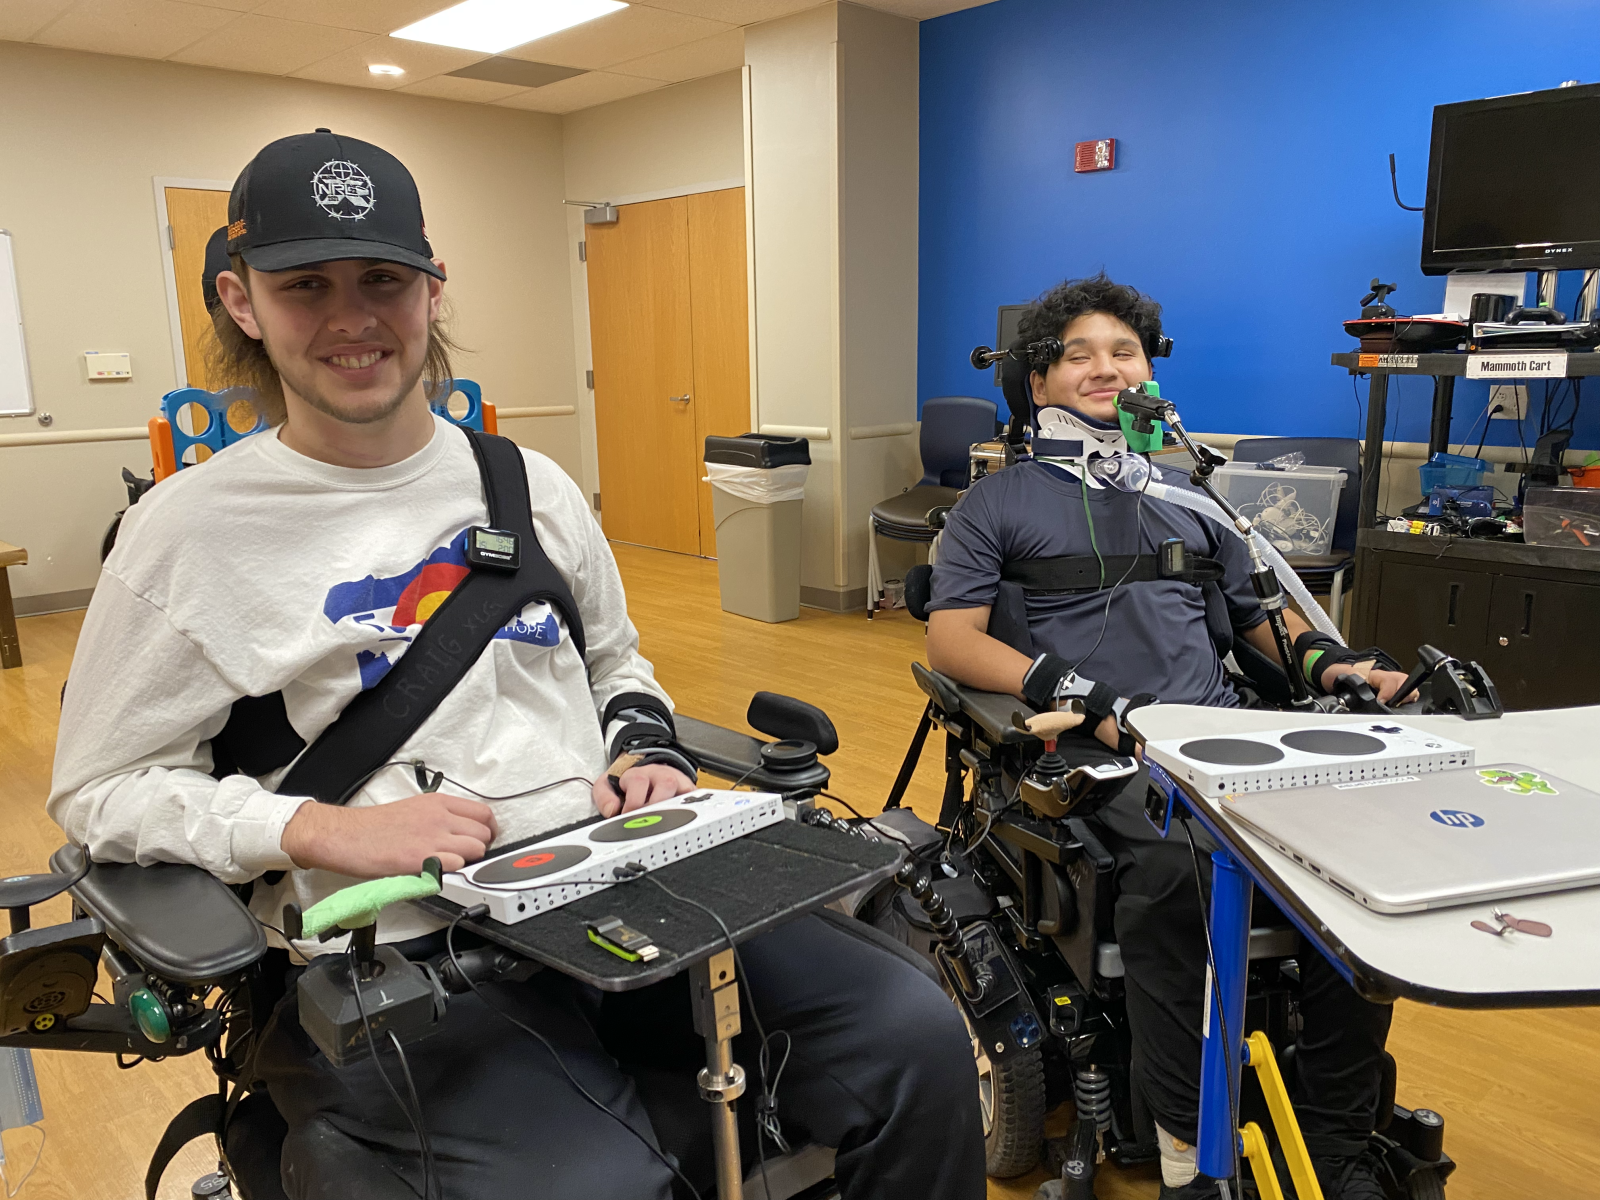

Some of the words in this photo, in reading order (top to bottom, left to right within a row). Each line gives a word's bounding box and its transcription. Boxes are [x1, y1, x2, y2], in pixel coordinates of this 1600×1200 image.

[1480, 360, 1527, 372] Mammoth
[1529, 360, 1551, 371] Cart
[1434, 810, 1476, 828] hp
